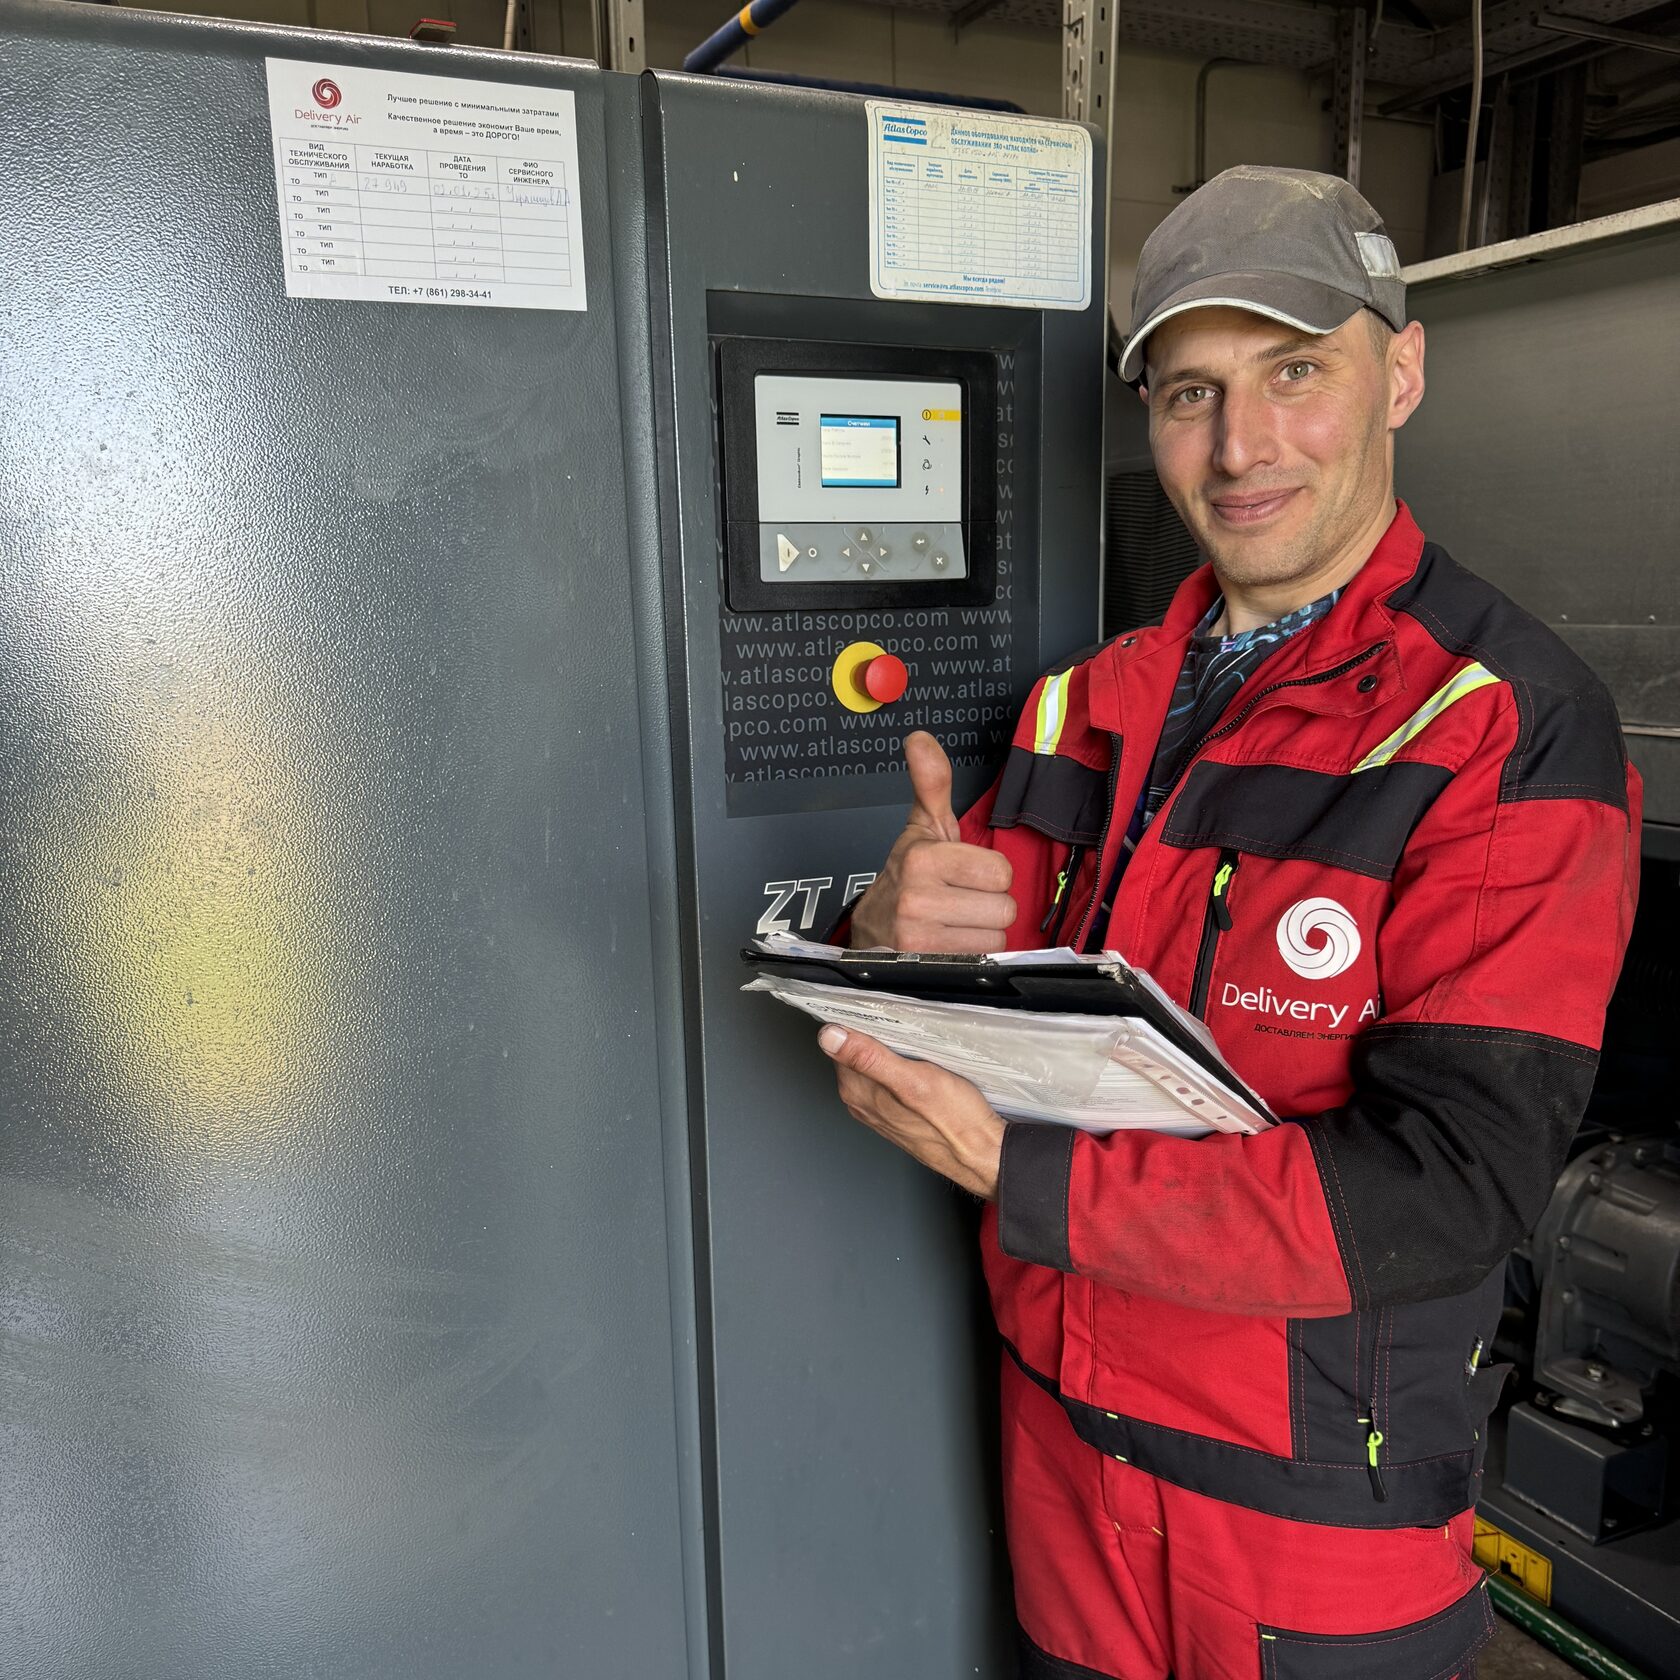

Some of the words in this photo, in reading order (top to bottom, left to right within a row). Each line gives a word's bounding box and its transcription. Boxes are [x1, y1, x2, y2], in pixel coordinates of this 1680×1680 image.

[388, 94, 417, 104] Лучшее
[419, 97, 453, 108] решение
[461, 102, 520, 114] минимальными
[522, 108, 560, 118] затратами
[294, 109, 342, 124] Delivery
[346, 114, 362, 124] Air
[388, 113, 441, 125] Качественное
[443, 118, 476, 129] решение
[478, 122, 513, 132] экономит
[515, 124, 535, 134] Ваше
[537, 128, 562, 137] время,
[884, 124, 906, 134] Atlas
[906, 126, 928, 136] Copco
[440, 128, 464, 137] время
[485, 131, 520, 141] ДОРОГО!
[308, 143, 325, 151] ВИД
[290, 150, 348, 161] ТЕХНИЧЕСКОГО
[375, 153, 409, 162] ТЕКУЩАЯ
[453, 156, 472, 164] ДАТА
[288, 159, 350, 170] ОБСЛУЖИВАНИЯ
[371, 161, 414, 170] НАРАБОТКА
[439, 163, 486, 173] ПРОВЕДЕНИЯ
[522, 161, 539, 169] ФИО
[508, 168, 554, 178] СЕРВИСНОГО
[513, 177, 550, 186] ИНЖЕНЕРА
[388, 286, 410, 295] ТЕЛ:
[413, 287, 423, 296] +7
[426, 287, 448, 298] (861)
[450, 289, 492, 299] 298-34-41
[756, 876, 833, 935] ZT
[1221, 982, 1349, 1028] Delivery
[1358, 994, 1381, 1023] Ai
[1254, 1023, 1315, 1039] ДОСТАВЛЯЕМ
[1317, 1032, 1354, 1041] ЭНЕРГИ
